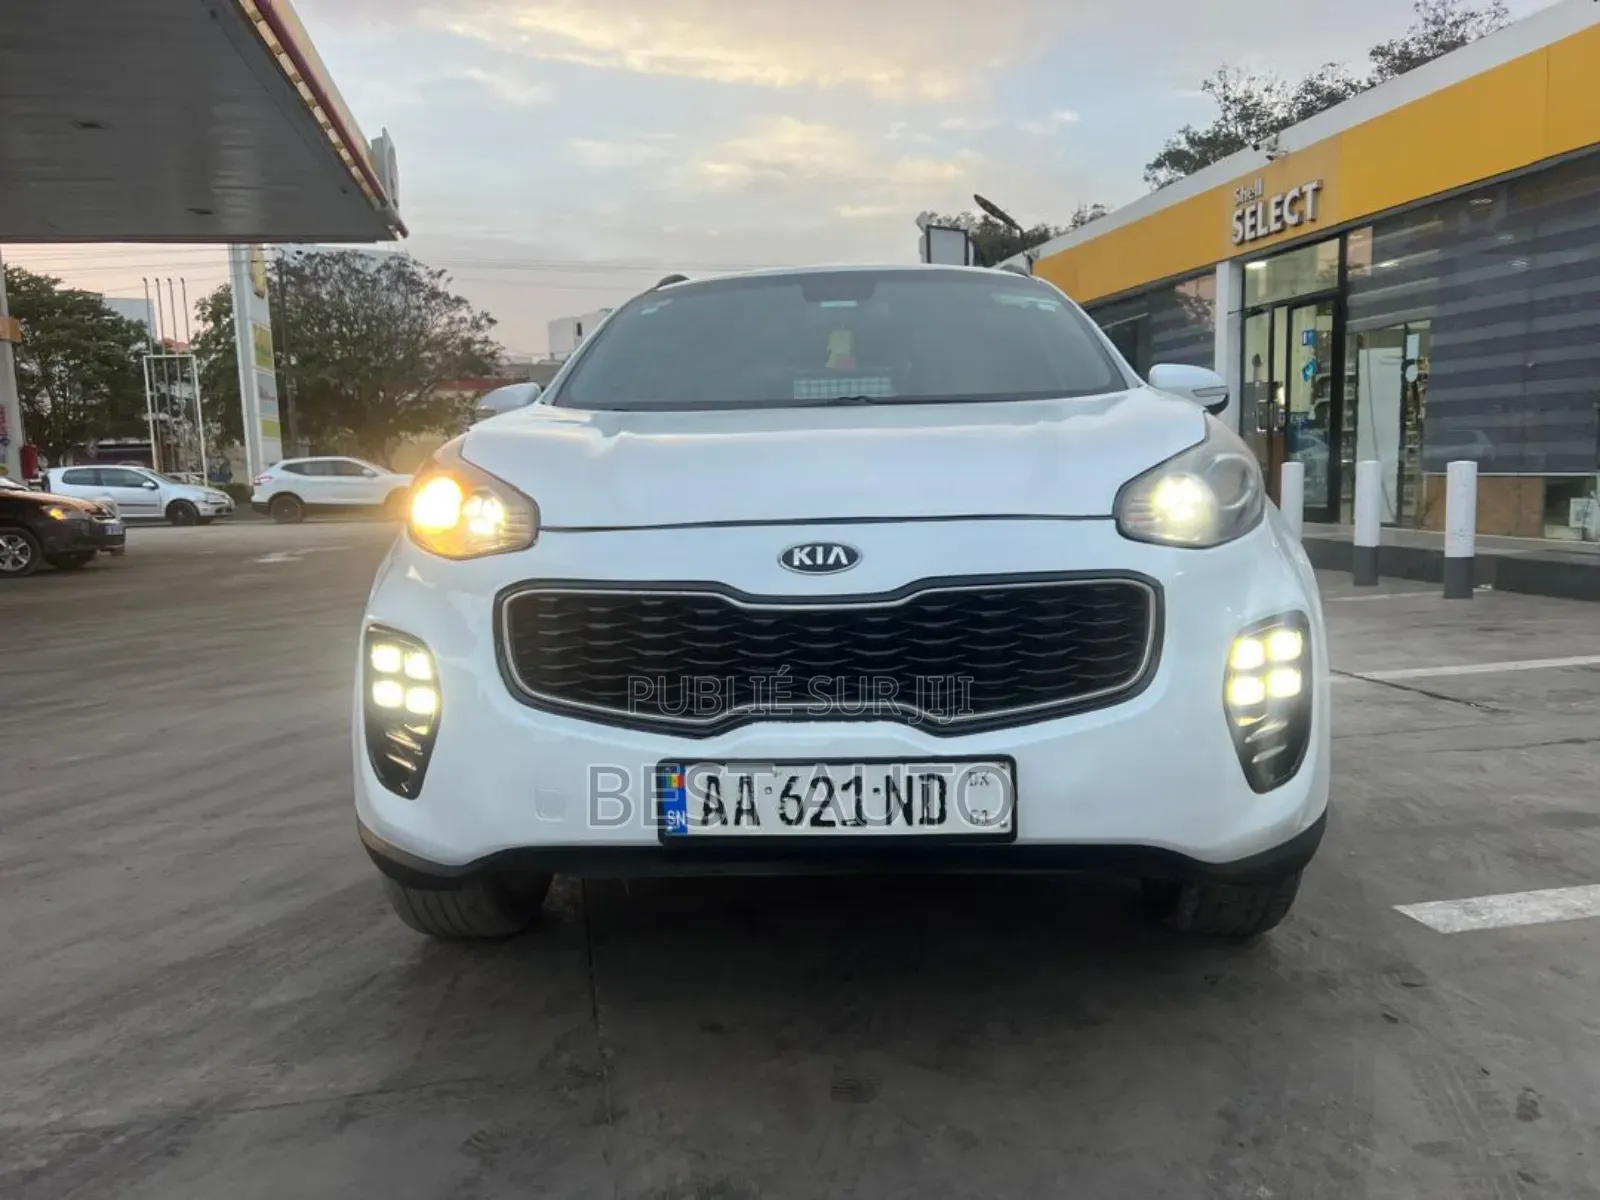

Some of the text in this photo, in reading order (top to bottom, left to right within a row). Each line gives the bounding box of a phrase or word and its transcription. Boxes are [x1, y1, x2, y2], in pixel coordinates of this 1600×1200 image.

[1234, 178, 1262, 206] Shell
[1232, 180, 1324, 245] SELECT
[793, 546, 849, 566] KIA
[667, 810, 686, 825] SN
